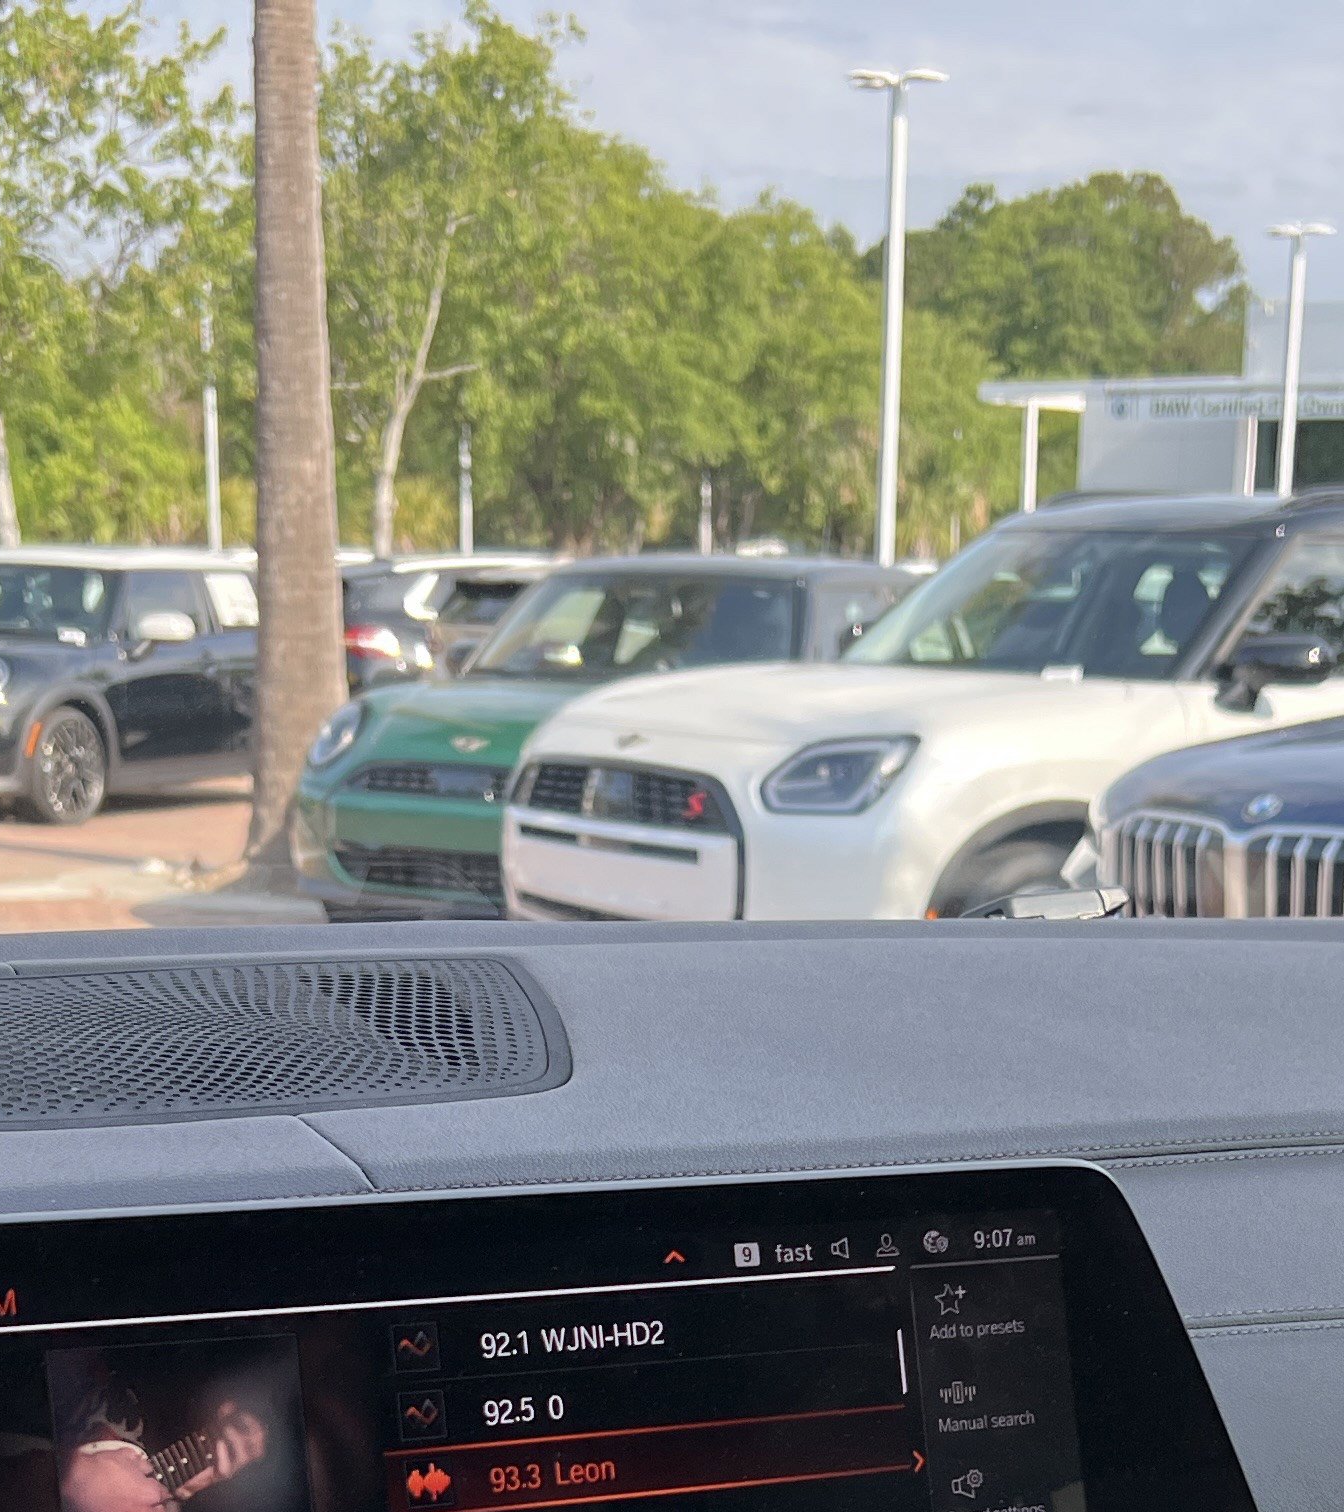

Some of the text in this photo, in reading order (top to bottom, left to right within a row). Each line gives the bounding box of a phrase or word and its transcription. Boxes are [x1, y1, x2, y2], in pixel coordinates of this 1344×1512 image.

[974, 1228, 1036, 1249] 9:07 am
[774, 1244, 814, 1263] fast
[480, 1320, 665, 1359] 92.1 WJNI-HD2
[929, 1319, 1025, 1340] Add to presets
[483, 1396, 535, 1426] 92.5
[938, 1410, 1036, 1433] Manual search
[489, 1460, 617, 1493] 93.3 Leon
